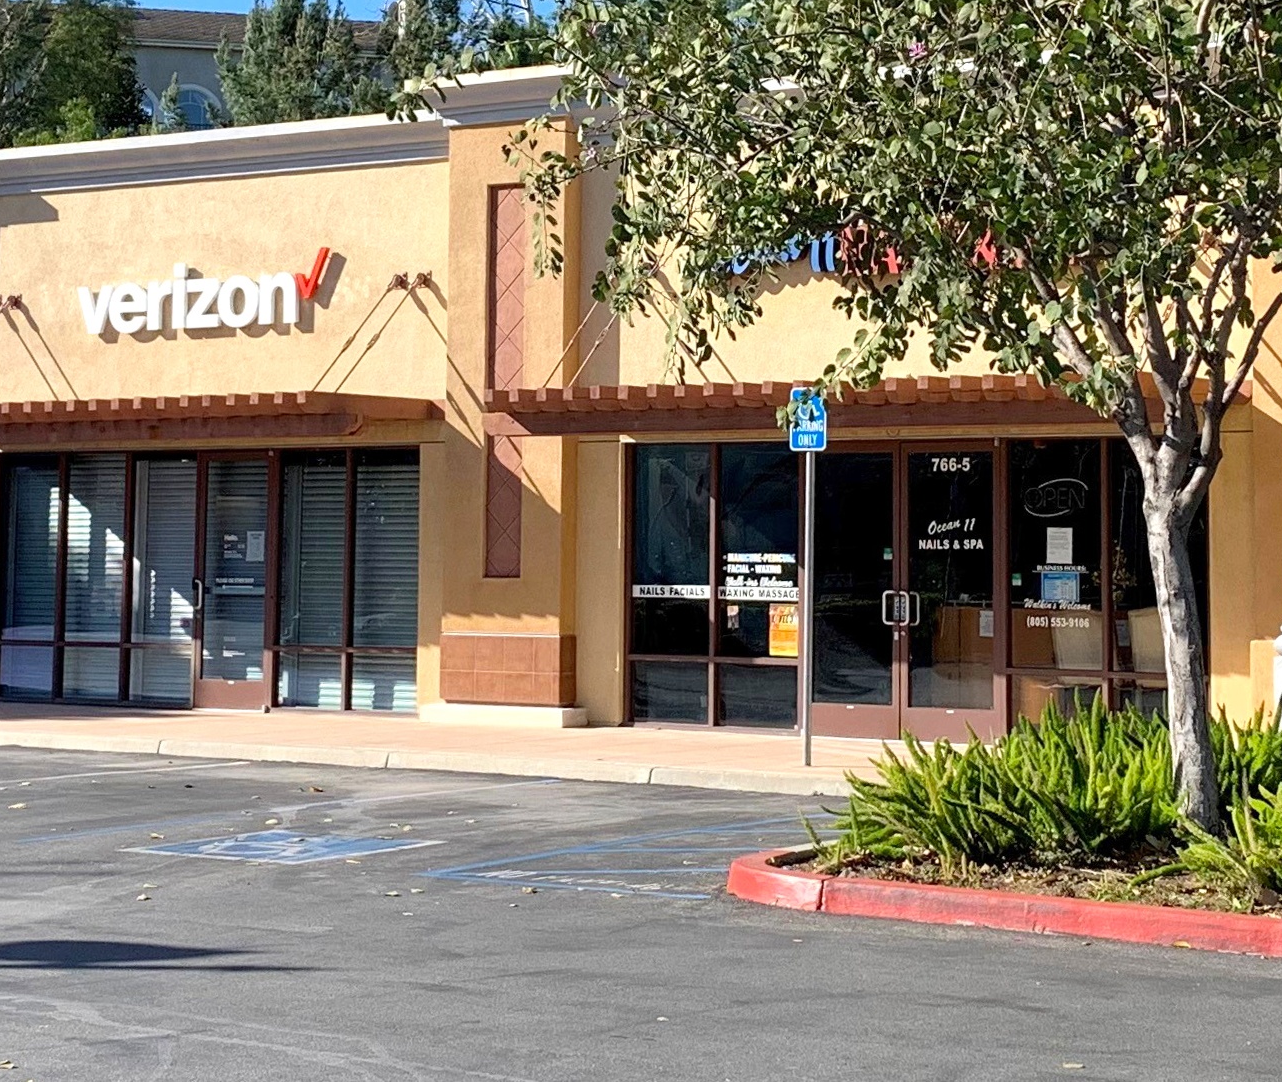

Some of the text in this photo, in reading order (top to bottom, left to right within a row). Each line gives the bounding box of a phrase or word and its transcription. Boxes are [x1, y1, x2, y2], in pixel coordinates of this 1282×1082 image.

[77, 262, 300, 335] verizon
[798, 433, 818, 446] ONLY
[931, 457, 971, 472] 766-5
[1024, 487, 1086, 509] OPEN
[927, 517, 976, 536] Ocean 11
[918, 539, 984, 550] NAILS & SPA
[639, 586, 706, 596] NAILS FACIALS
[719, 588, 755, 598] WAXING
[1026, 615, 1090, 629] (805) 553-9106
